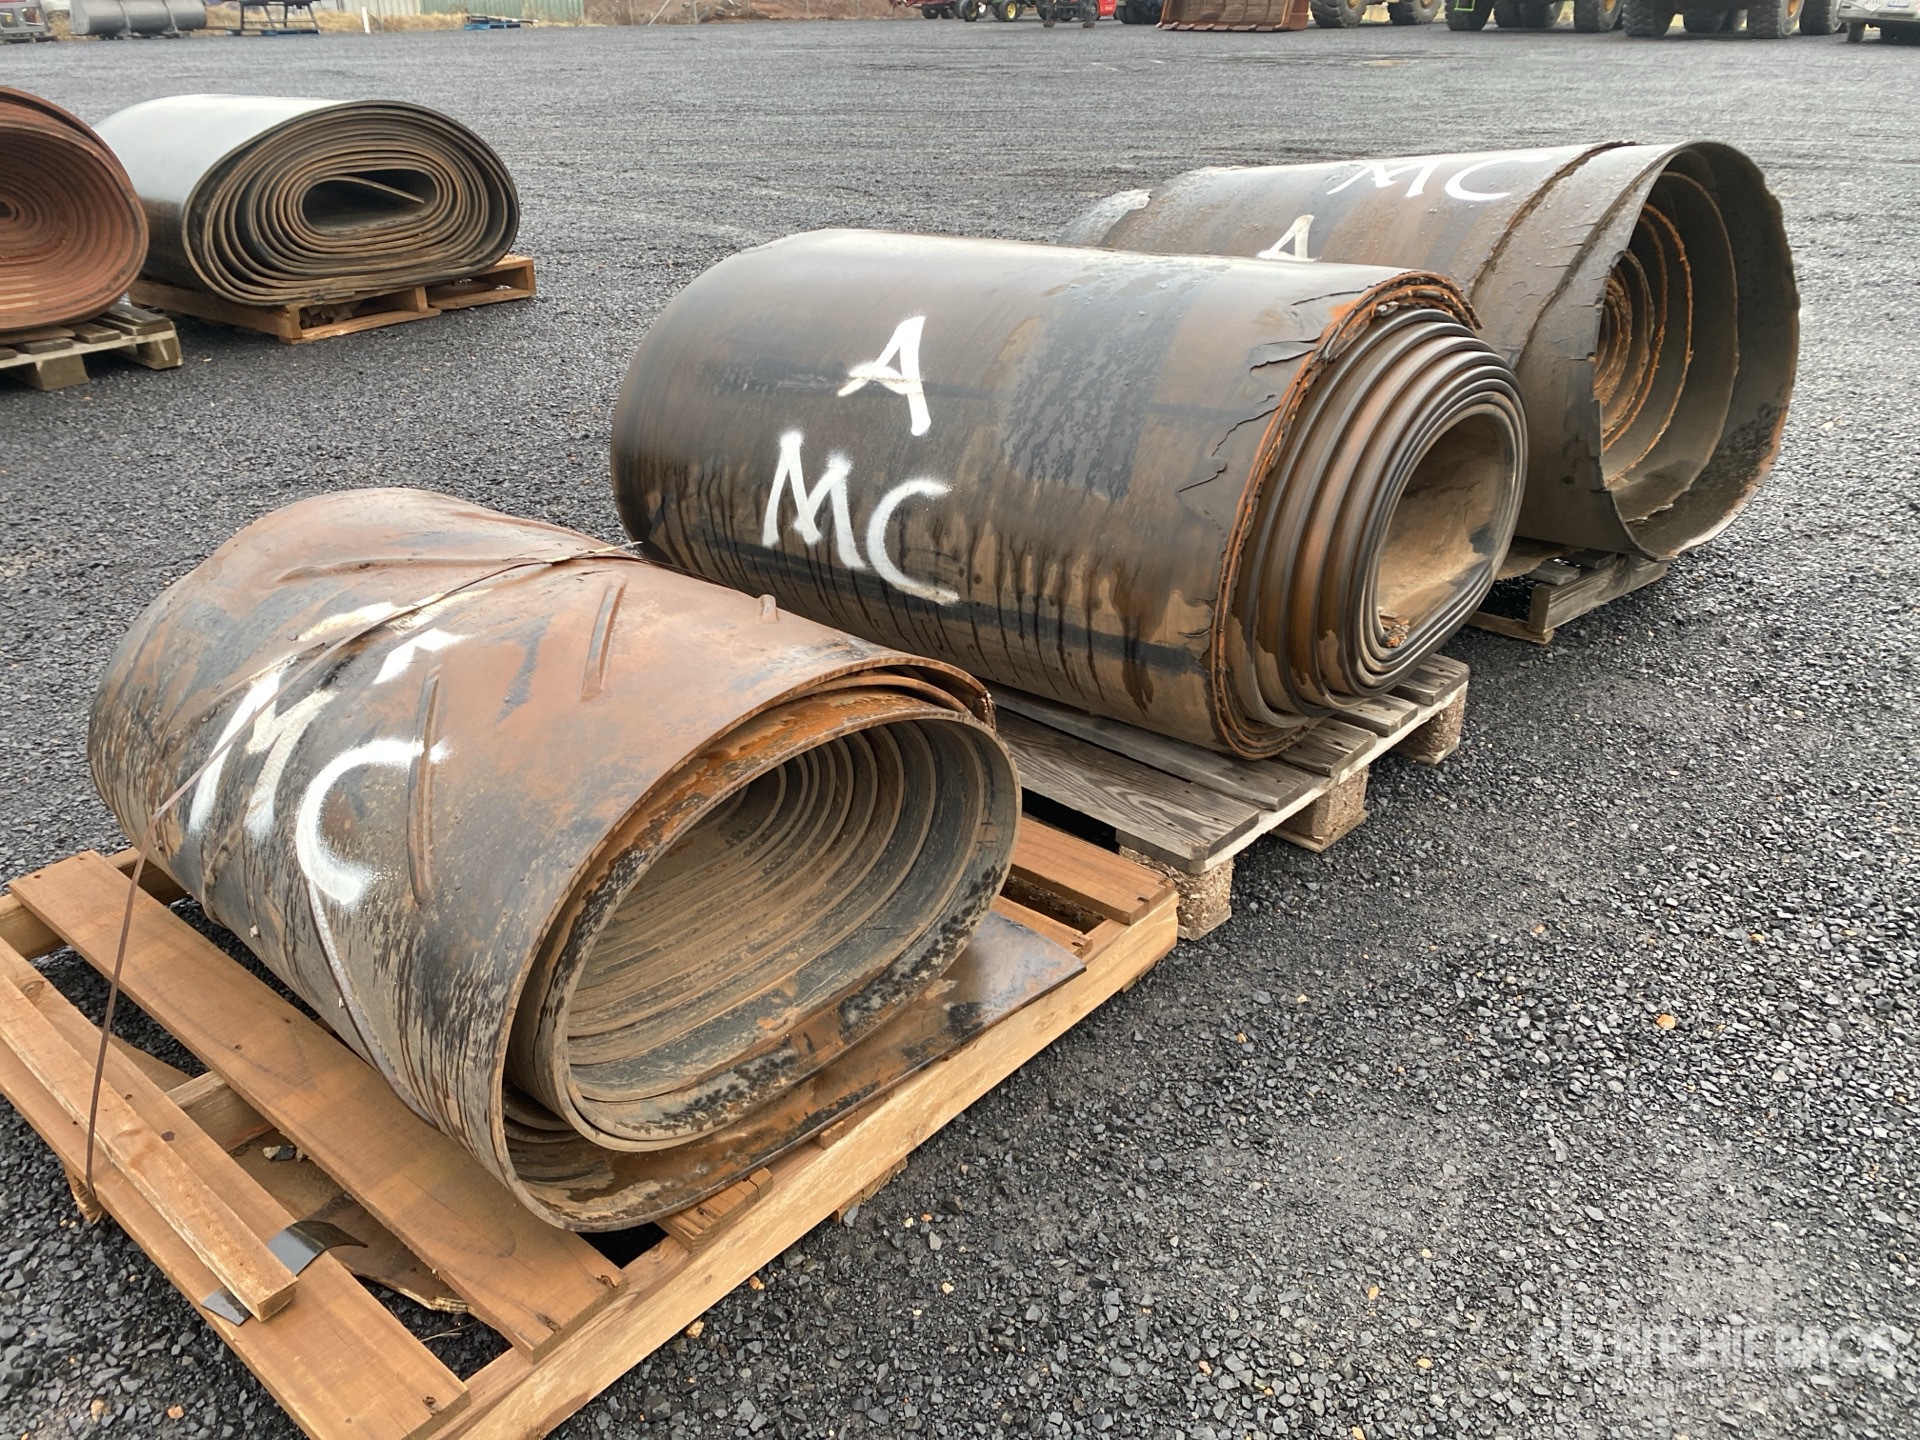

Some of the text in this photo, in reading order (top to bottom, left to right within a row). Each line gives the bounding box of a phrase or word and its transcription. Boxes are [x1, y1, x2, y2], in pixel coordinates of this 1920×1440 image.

[1325, 155, 1554, 201] MC
[836, 315, 932, 436] A
[761, 430, 960, 606] MC
[187, 655, 454, 908] MC
